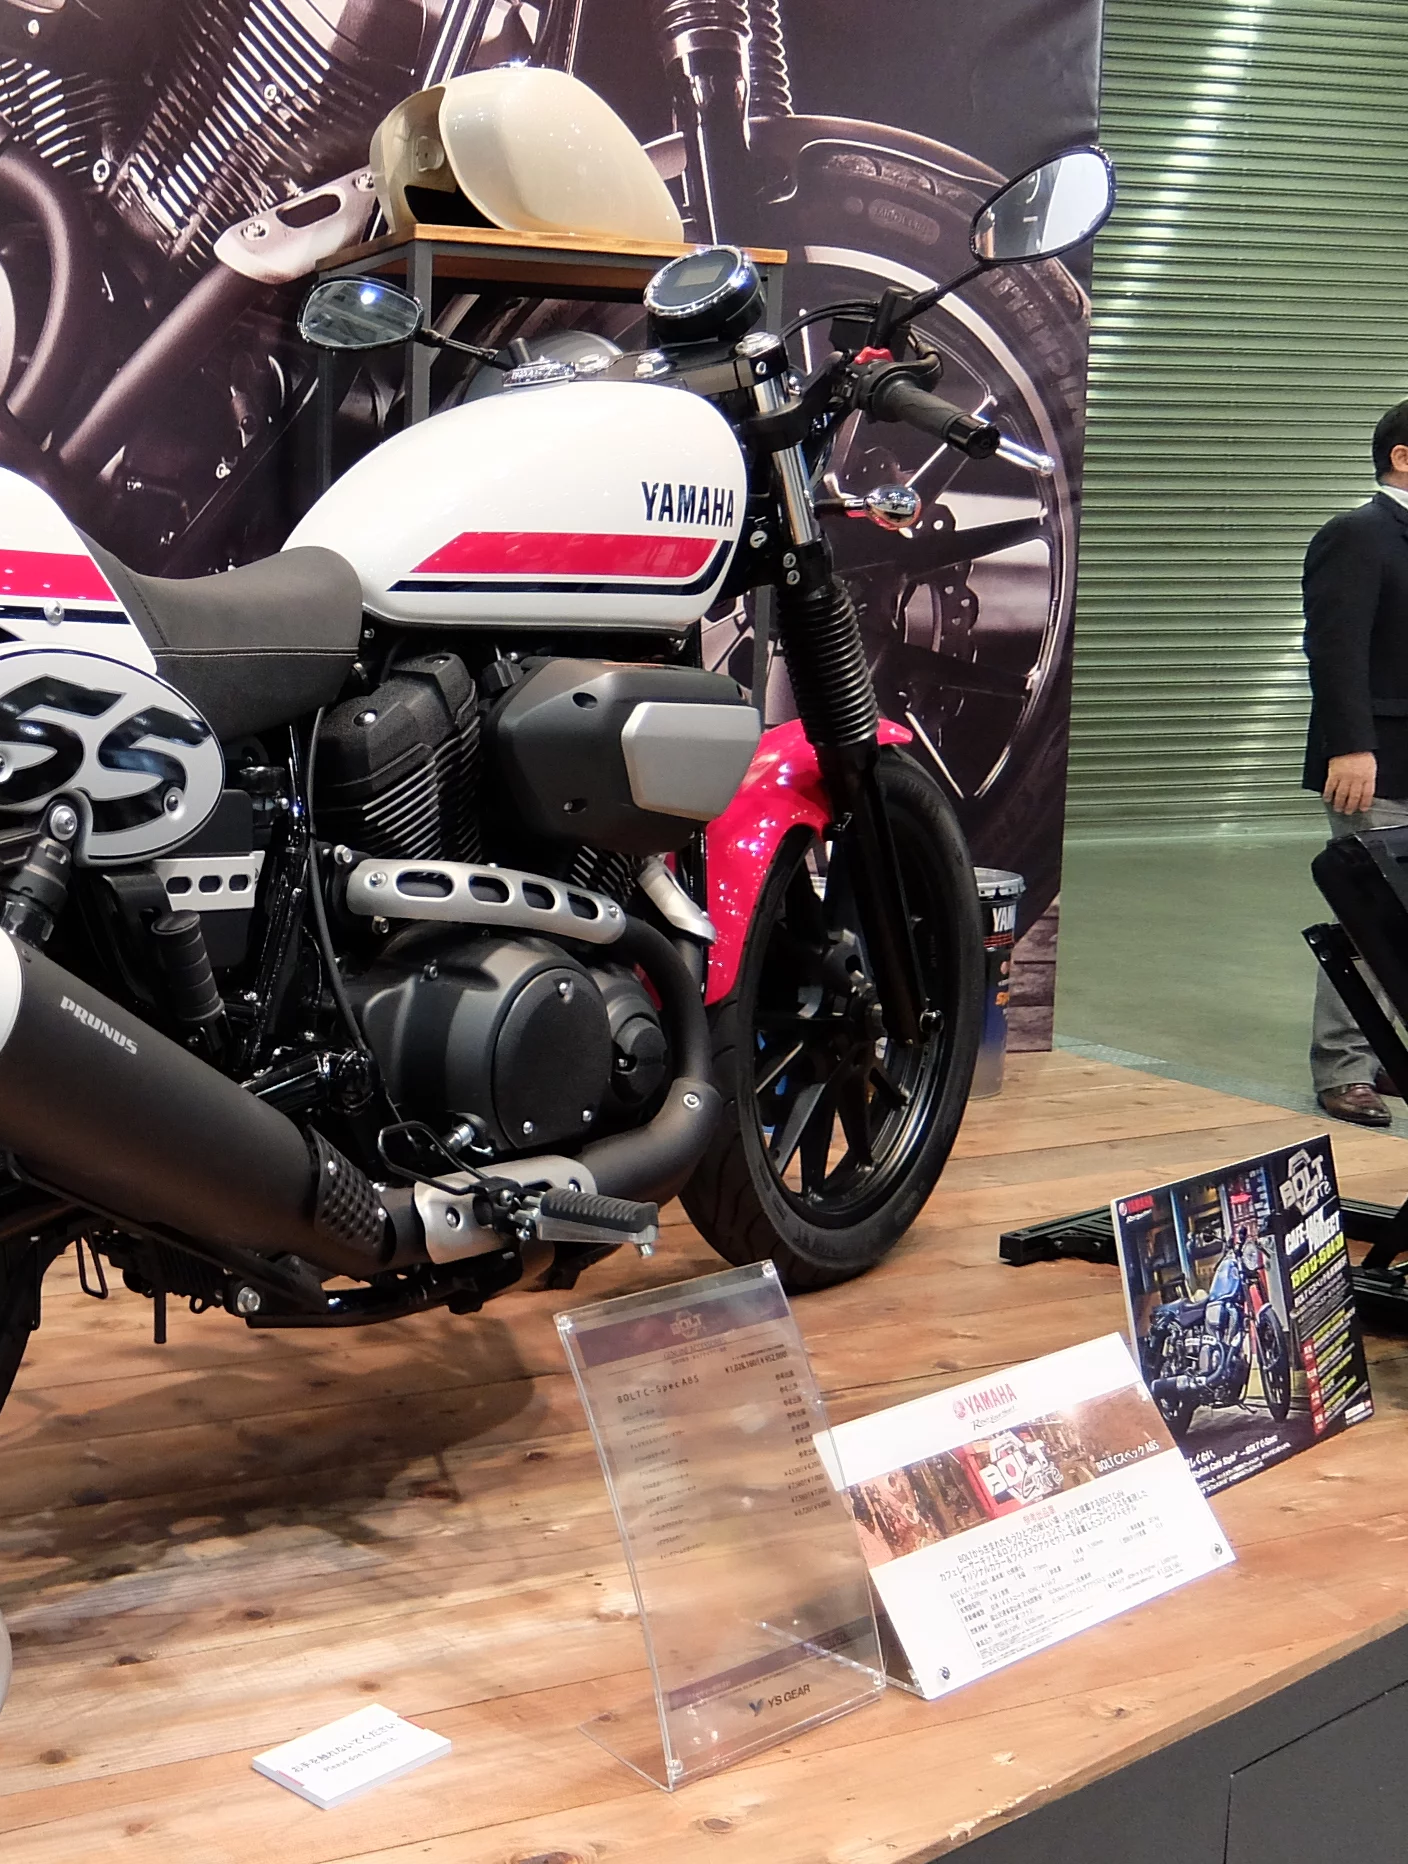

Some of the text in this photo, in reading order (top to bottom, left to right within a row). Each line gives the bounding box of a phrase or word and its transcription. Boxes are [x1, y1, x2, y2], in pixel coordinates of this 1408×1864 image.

[641, 481, 734, 528] YAMAHA
[60, 995, 139, 1055] PRUNUS
[617, 1389, 642, 1404] BOLT
[964, 1383, 1018, 1415] YAMAHA
[979, 1439, 1049, 1497] BOLT
[1095, 1456, 1115, 1474] BOLT
[784, 1684, 812, 1702] GEAR
